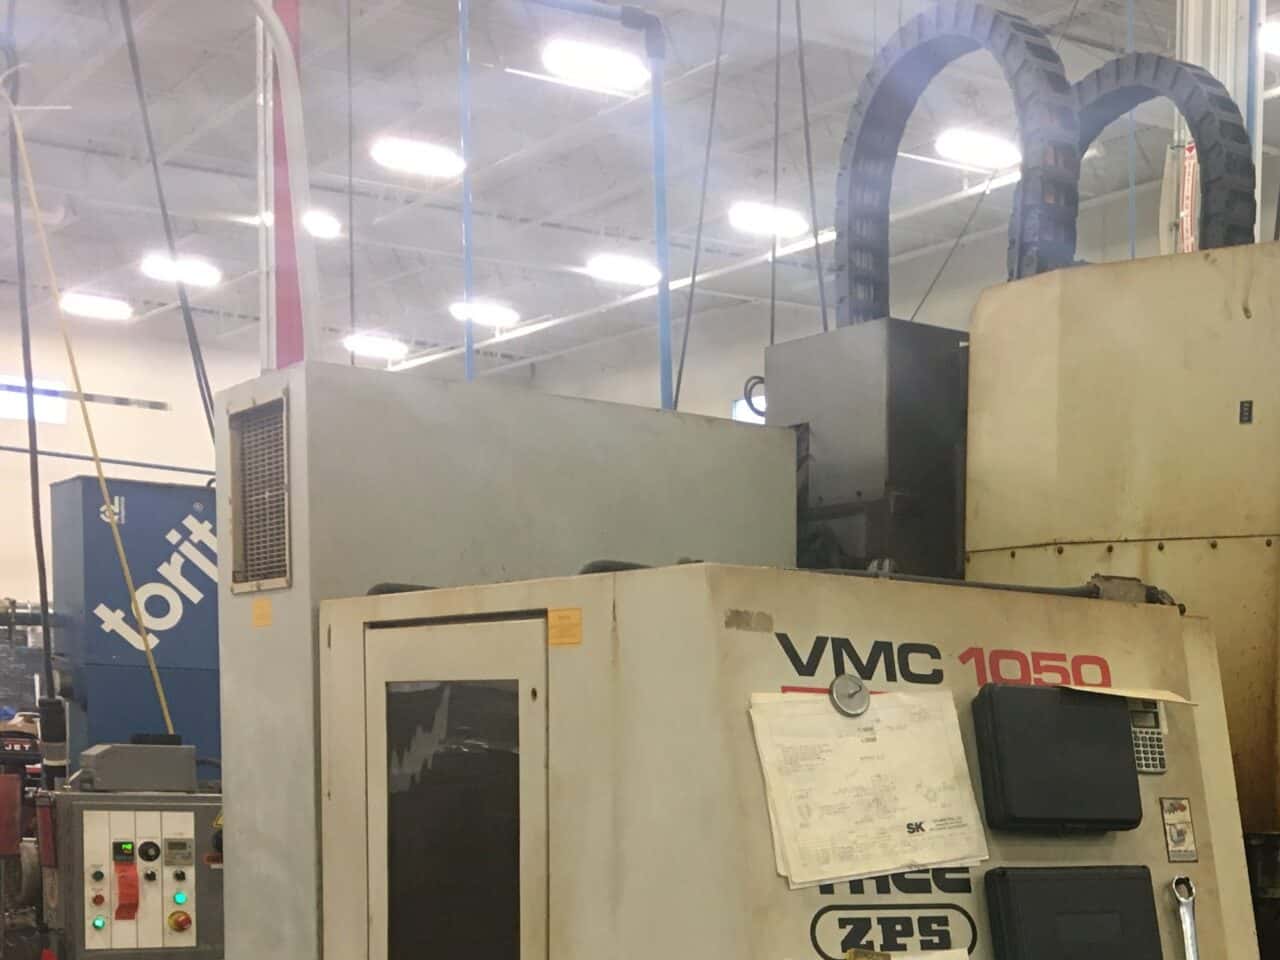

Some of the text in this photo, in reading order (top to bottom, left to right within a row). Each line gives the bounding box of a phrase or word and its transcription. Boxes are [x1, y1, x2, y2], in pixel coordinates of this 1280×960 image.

[93, 514, 217, 651] torit
[775, 632, 1111, 687] VMC 1050
[4, 743, 31, 751] JET
[906, 821, 925, 834] SK
[838, 915, 952, 953] ZPS
